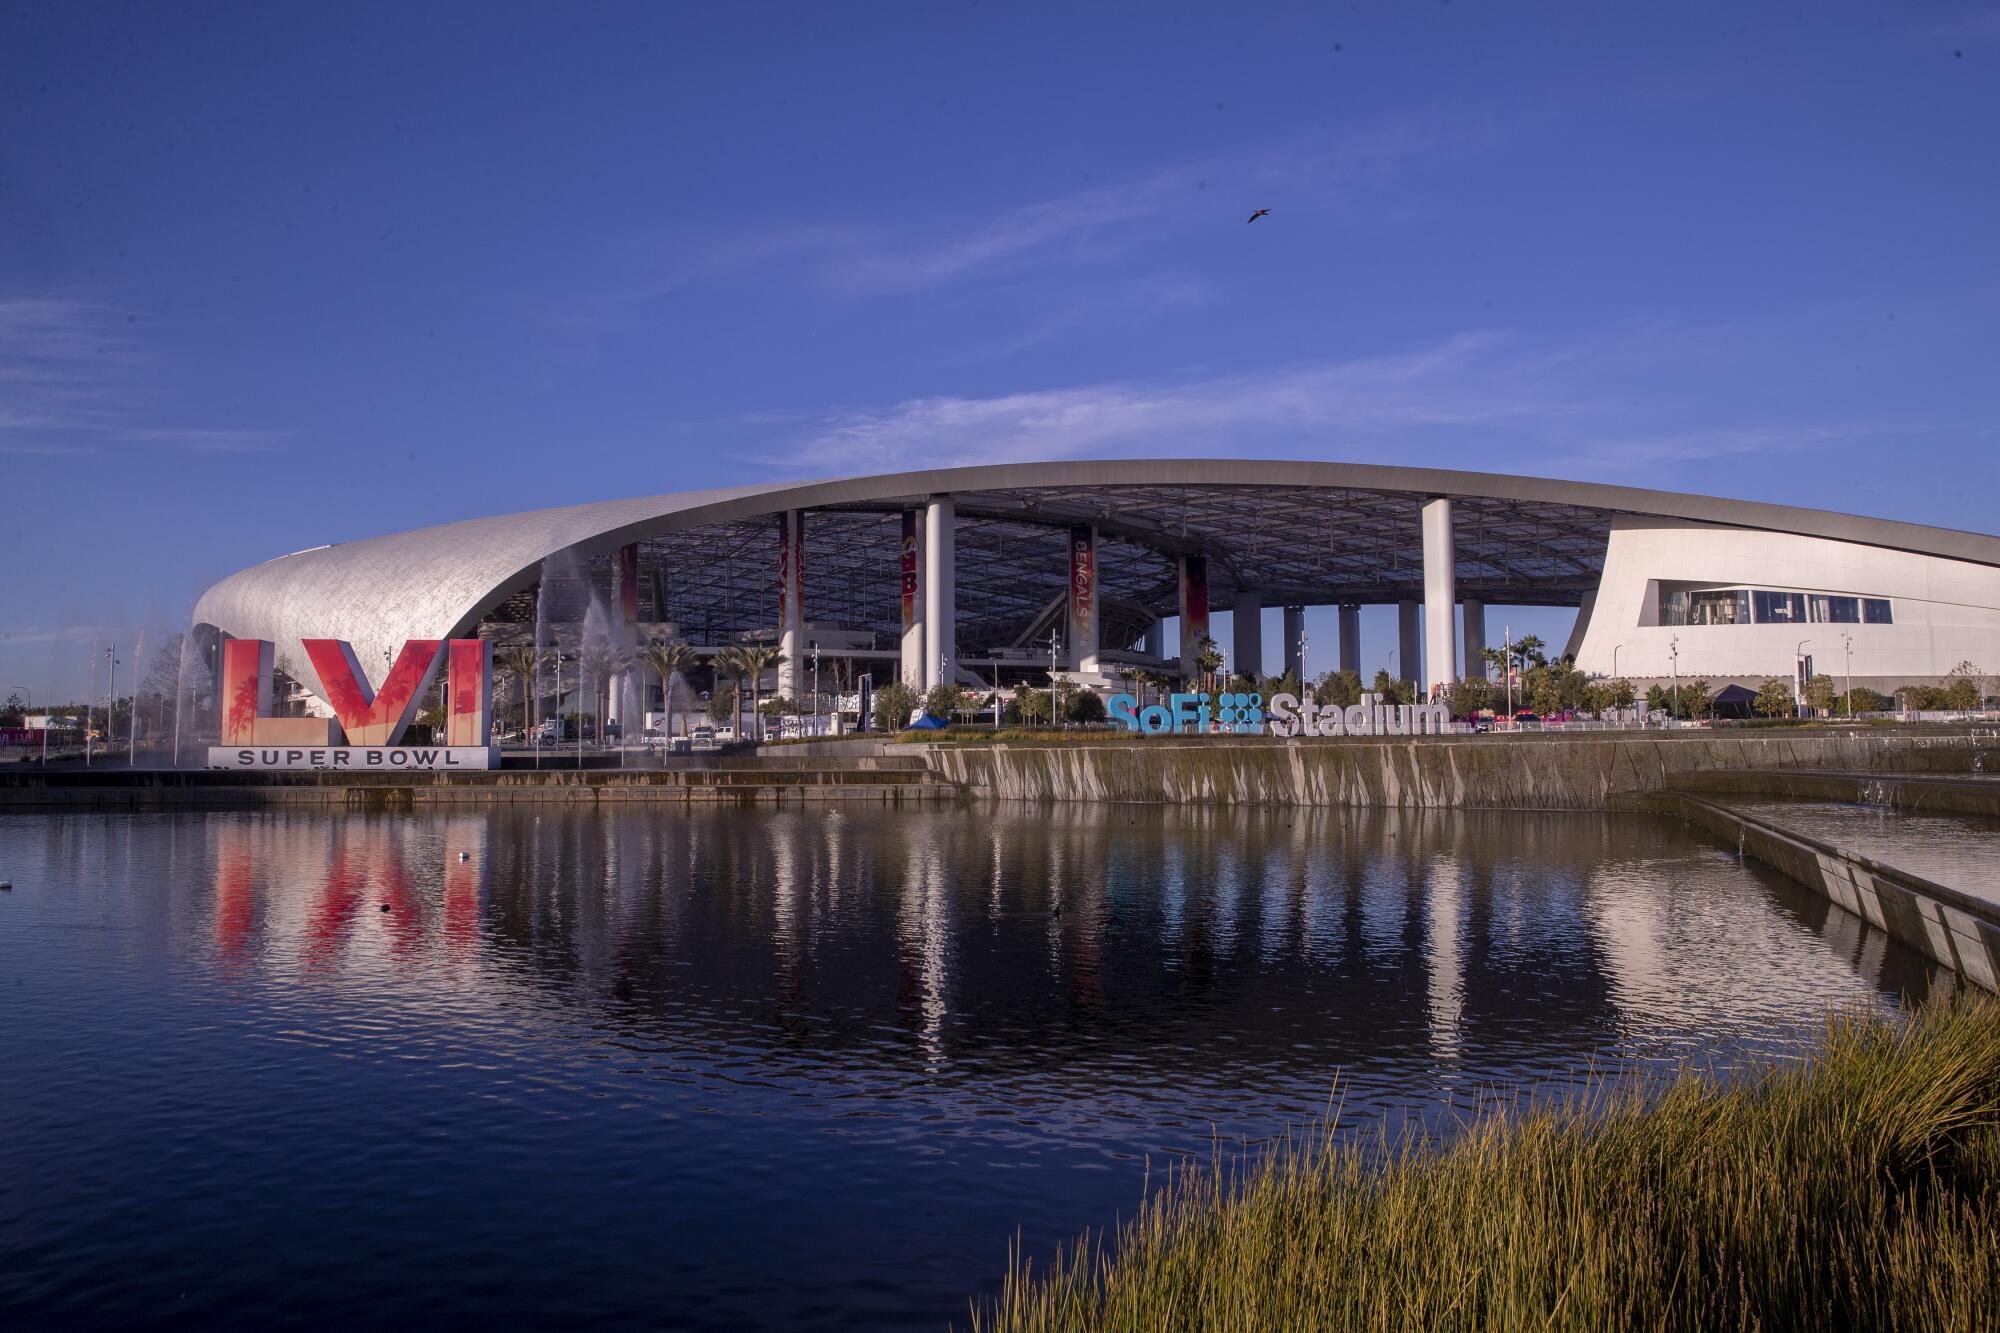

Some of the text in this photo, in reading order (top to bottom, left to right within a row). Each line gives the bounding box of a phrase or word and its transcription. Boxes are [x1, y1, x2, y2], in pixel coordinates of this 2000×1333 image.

[1075, 540, 1088, 617] BENGALS
[221, 639, 491, 746] LVI
[1107, 693, 1451, 737] SoFi Stadium
[238, 750, 460, 765] SUPER BOWL
